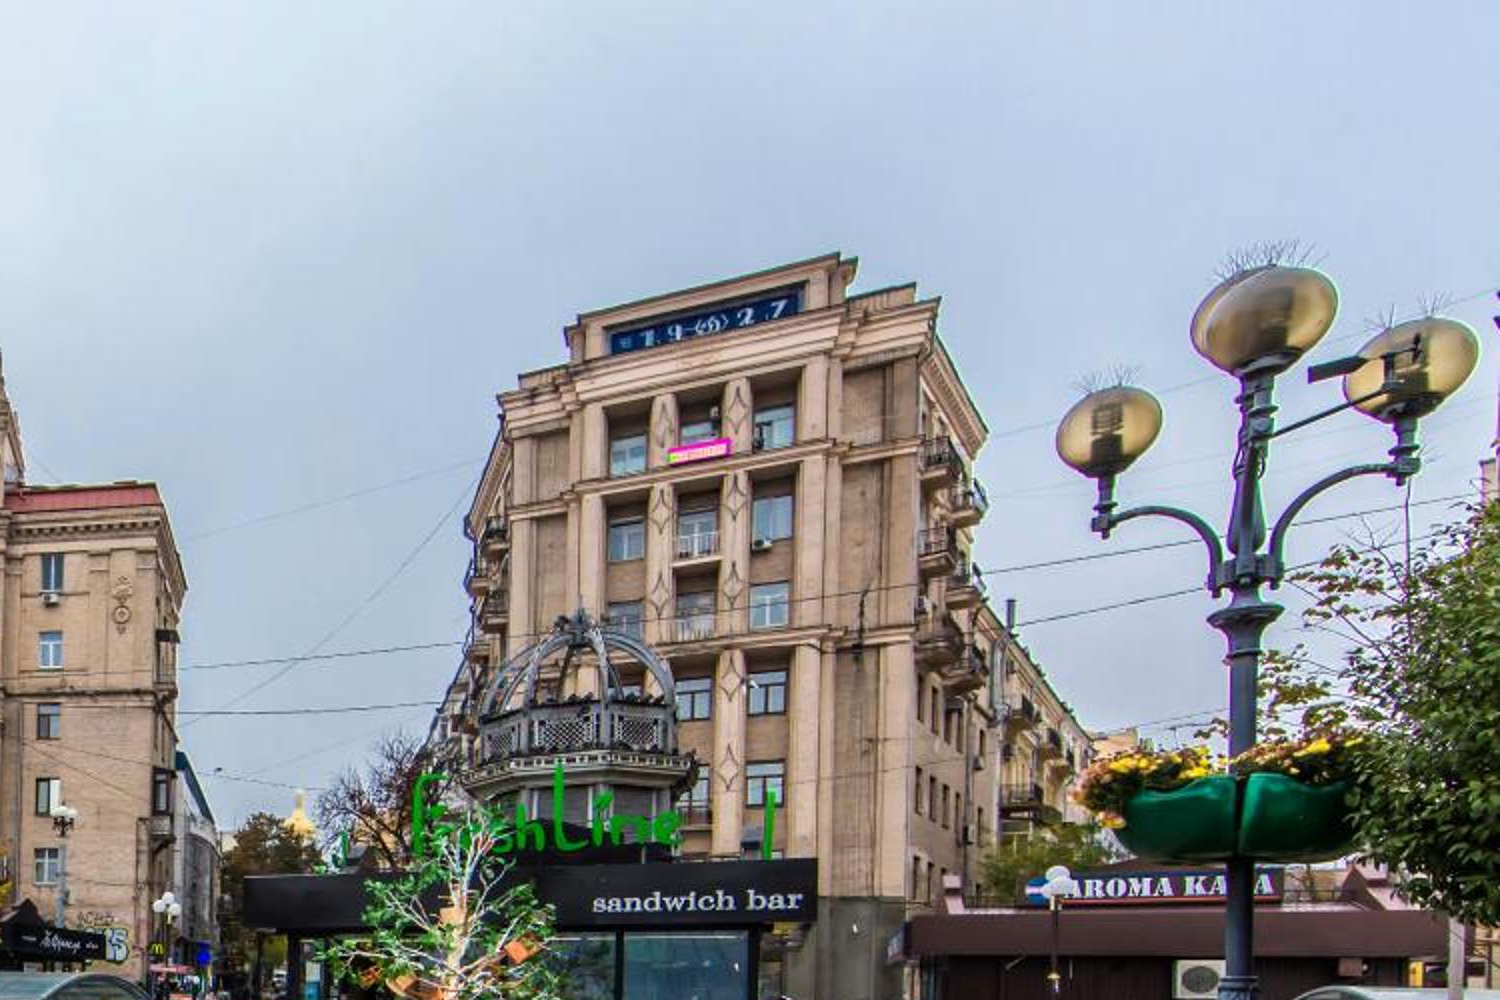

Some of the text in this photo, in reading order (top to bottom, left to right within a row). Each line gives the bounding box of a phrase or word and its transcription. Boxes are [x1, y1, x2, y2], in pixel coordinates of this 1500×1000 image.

[1184, 874, 1274, 896] KAA
[592, 889, 804, 913] sandwich bar
